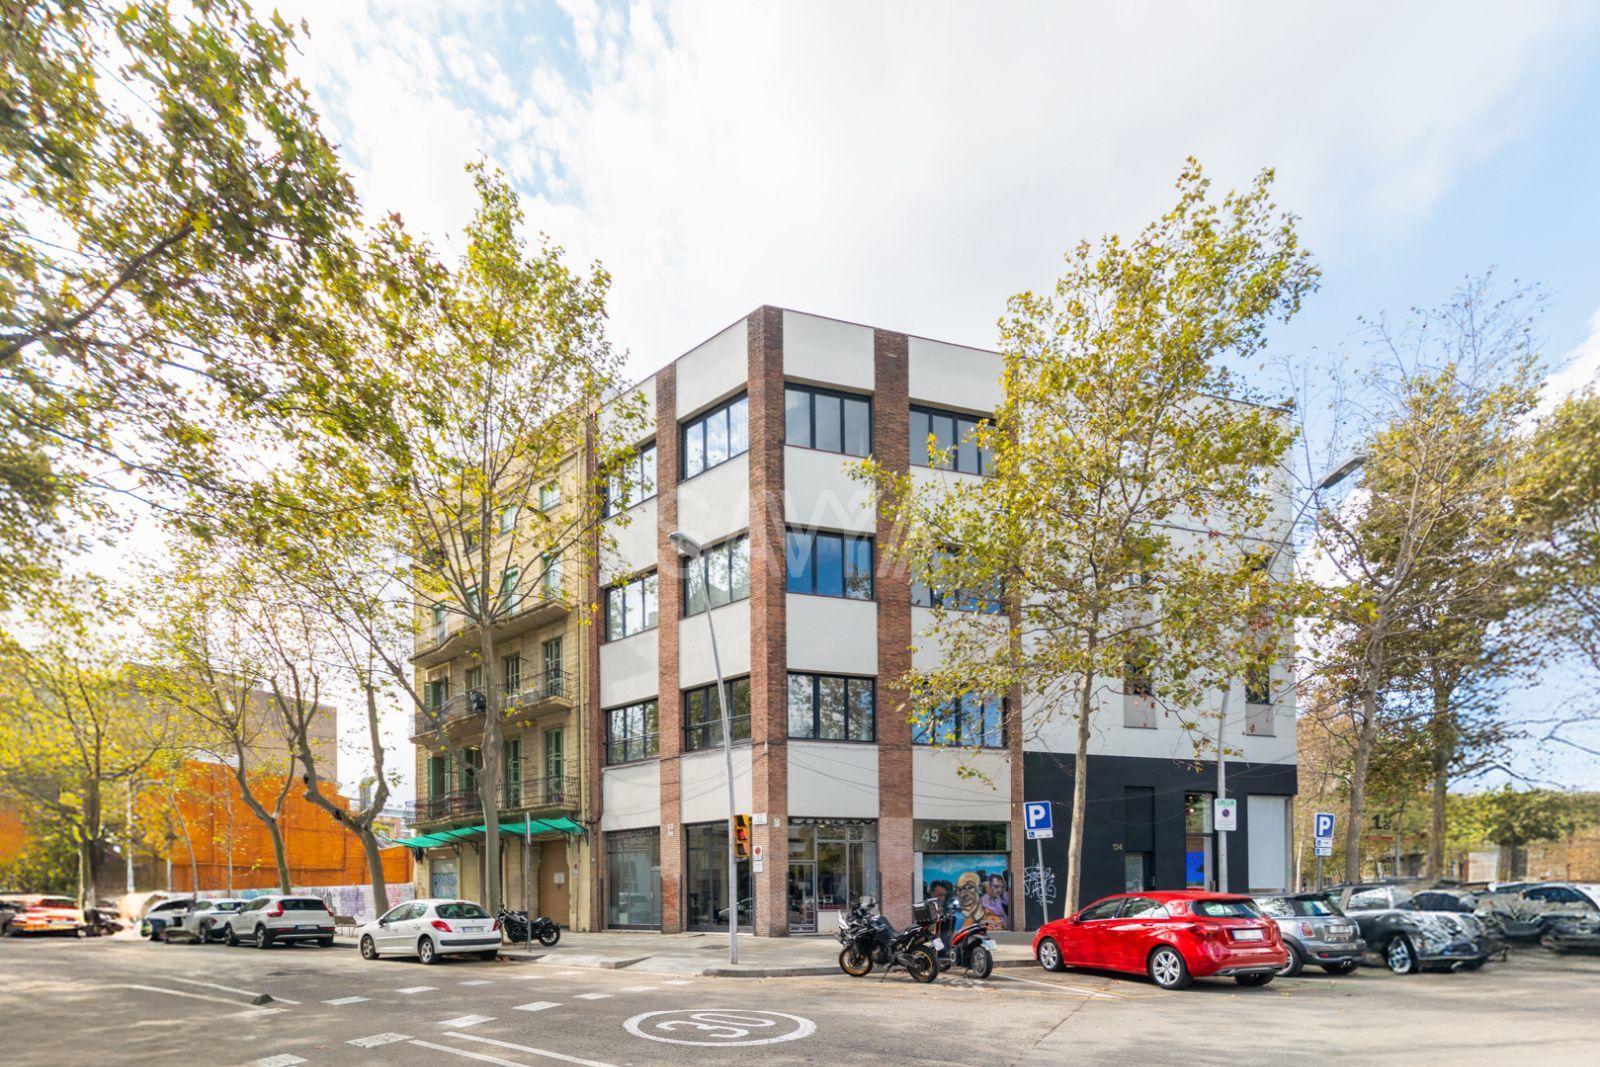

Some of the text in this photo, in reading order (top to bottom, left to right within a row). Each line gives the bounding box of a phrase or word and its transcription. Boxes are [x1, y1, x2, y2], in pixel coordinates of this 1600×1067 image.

[1028, 804, 1046, 828] P
[1318, 815, 1331, 836] P
[922, 828, 940, 843] 45
